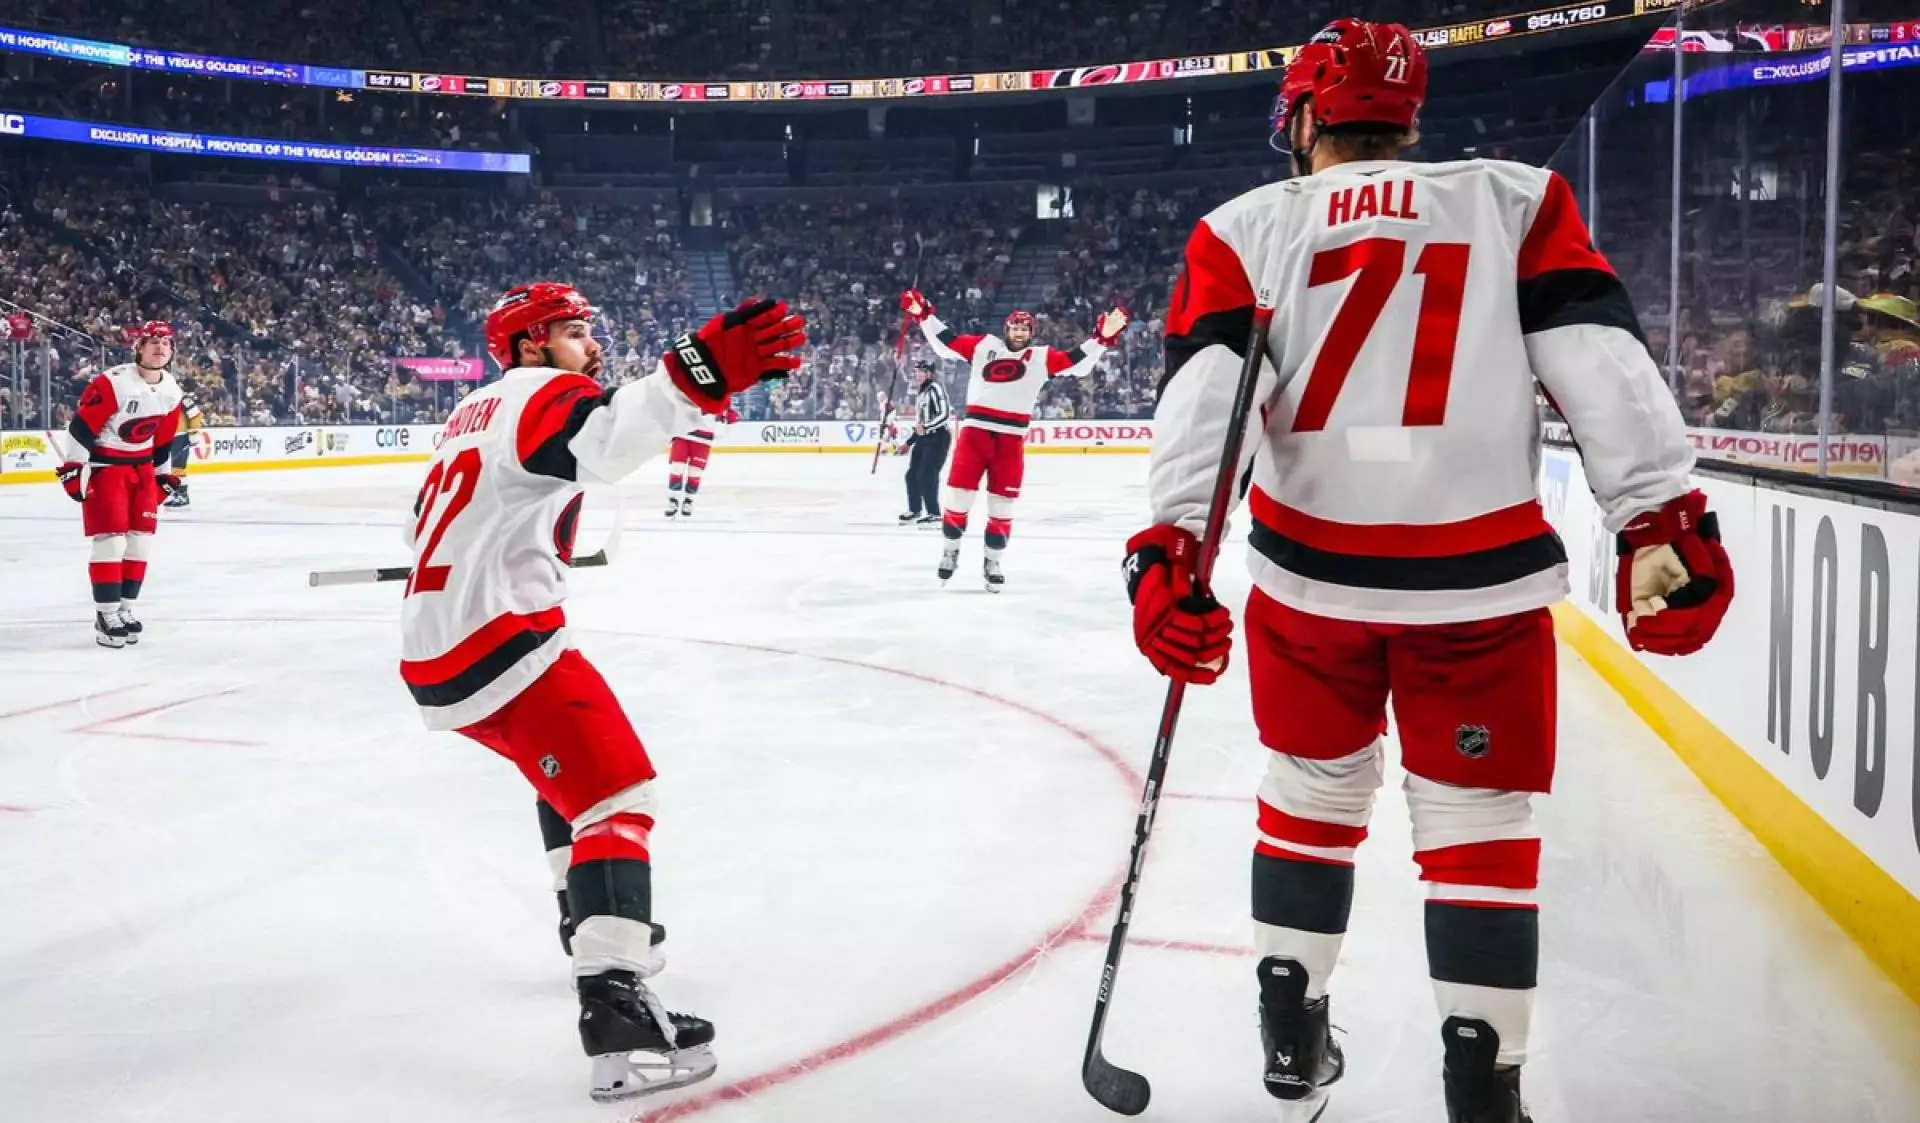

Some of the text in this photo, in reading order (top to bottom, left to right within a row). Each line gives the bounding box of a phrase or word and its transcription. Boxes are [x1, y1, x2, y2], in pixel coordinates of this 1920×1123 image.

[1449, 24, 1485, 43] RAFFLE
[18, 36, 70, 52] HOSPITAL
[144, 54, 165, 65] THE
[167, 57, 203, 70] VEGAS
[1842, 44, 1920, 67] SPITAL
[90, 128, 149, 144] EXCLUSIVE
[152, 135, 204, 150] HOSPITAL
[208, 140, 262, 154] PROVIDER
[265, 144, 280, 155] OF
[283, 146, 303, 157] THE
[306, 148, 341, 160] VEGAS
[344, 151, 389, 163] GOLDEN
[1327, 180, 1418, 227] HALL
[1291, 237, 1471, 432] 71
[214, 434, 262, 455] paylocity
[376, 427, 410, 448] core
[1053, 426, 1153, 439] HONDA
[1767, 503, 1920, 855] NOB
